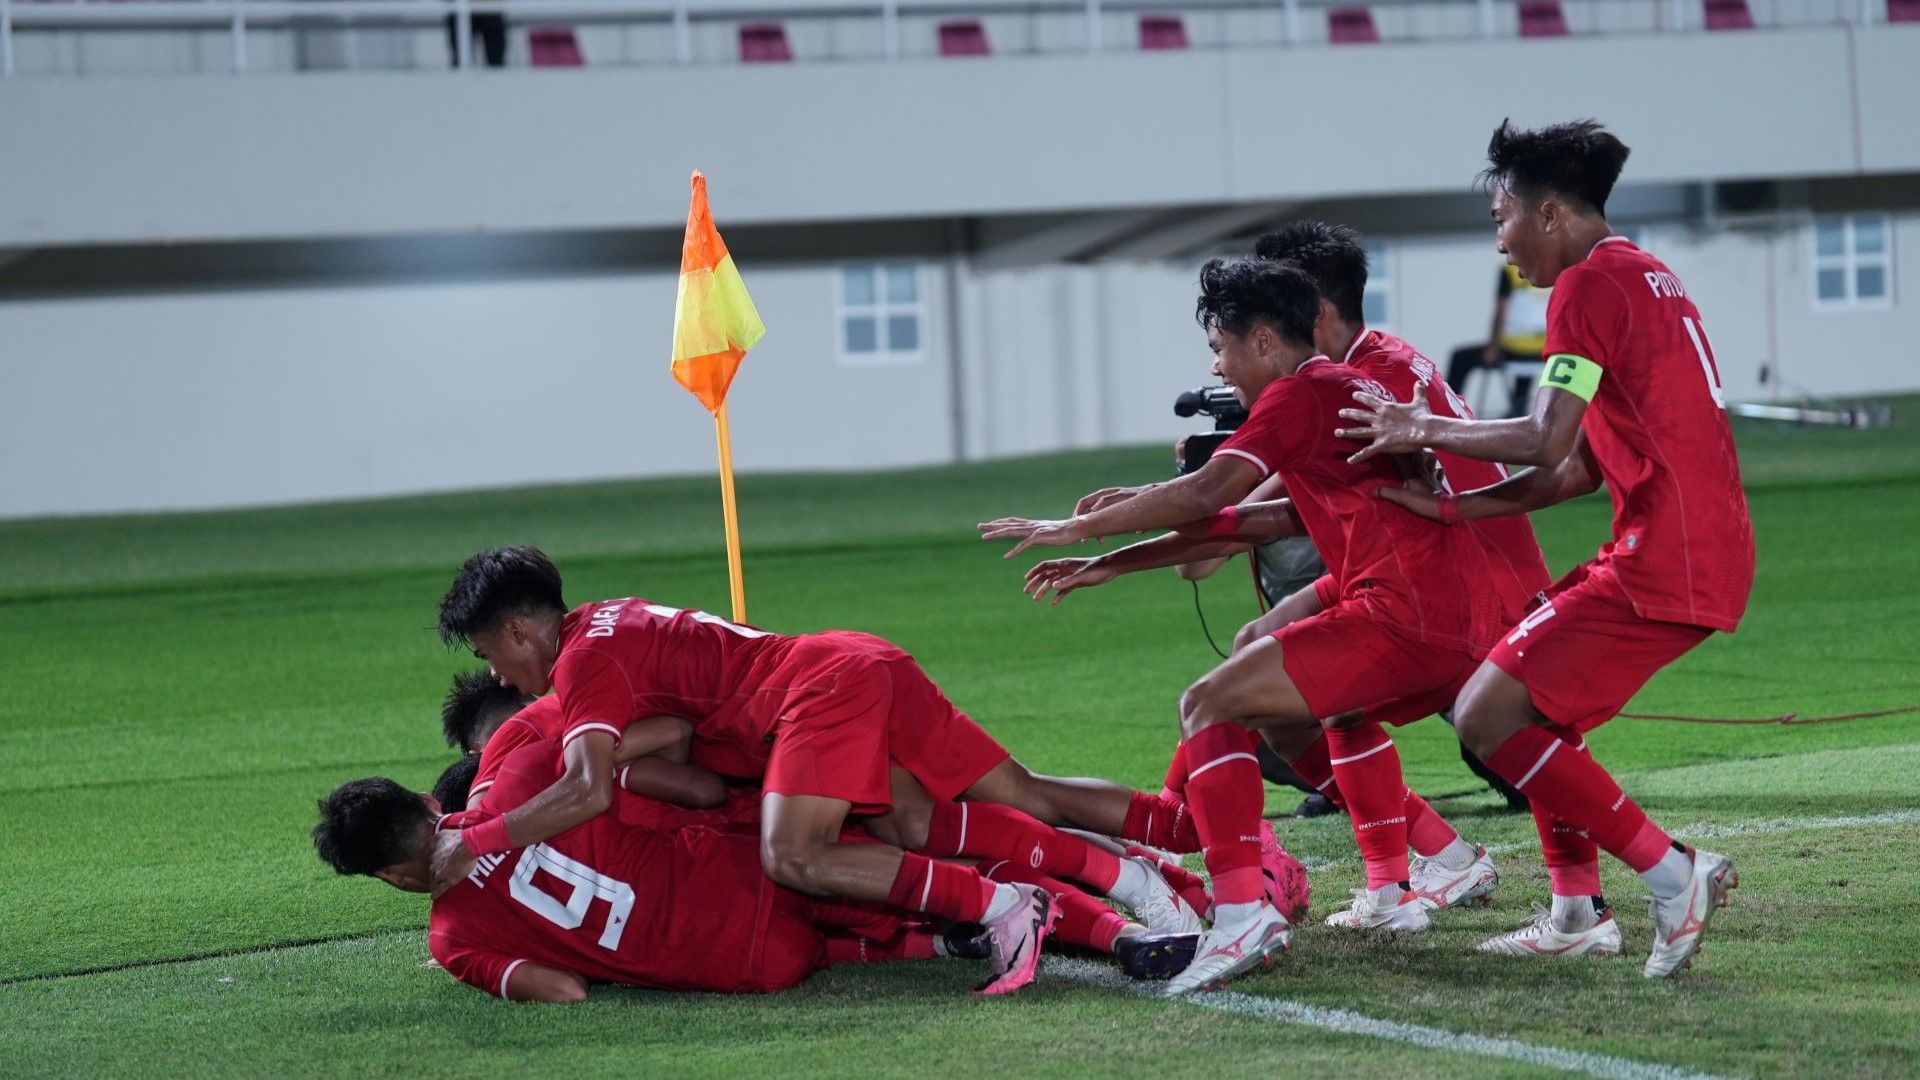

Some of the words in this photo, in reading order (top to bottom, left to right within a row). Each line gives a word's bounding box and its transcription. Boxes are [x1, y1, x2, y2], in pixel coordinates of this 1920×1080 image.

[1549, 357, 1577, 385] C
[586, 600, 623, 637] DAFA
[1359, 816, 1406, 830] INDONES
[508, 842, 636, 951] 9
